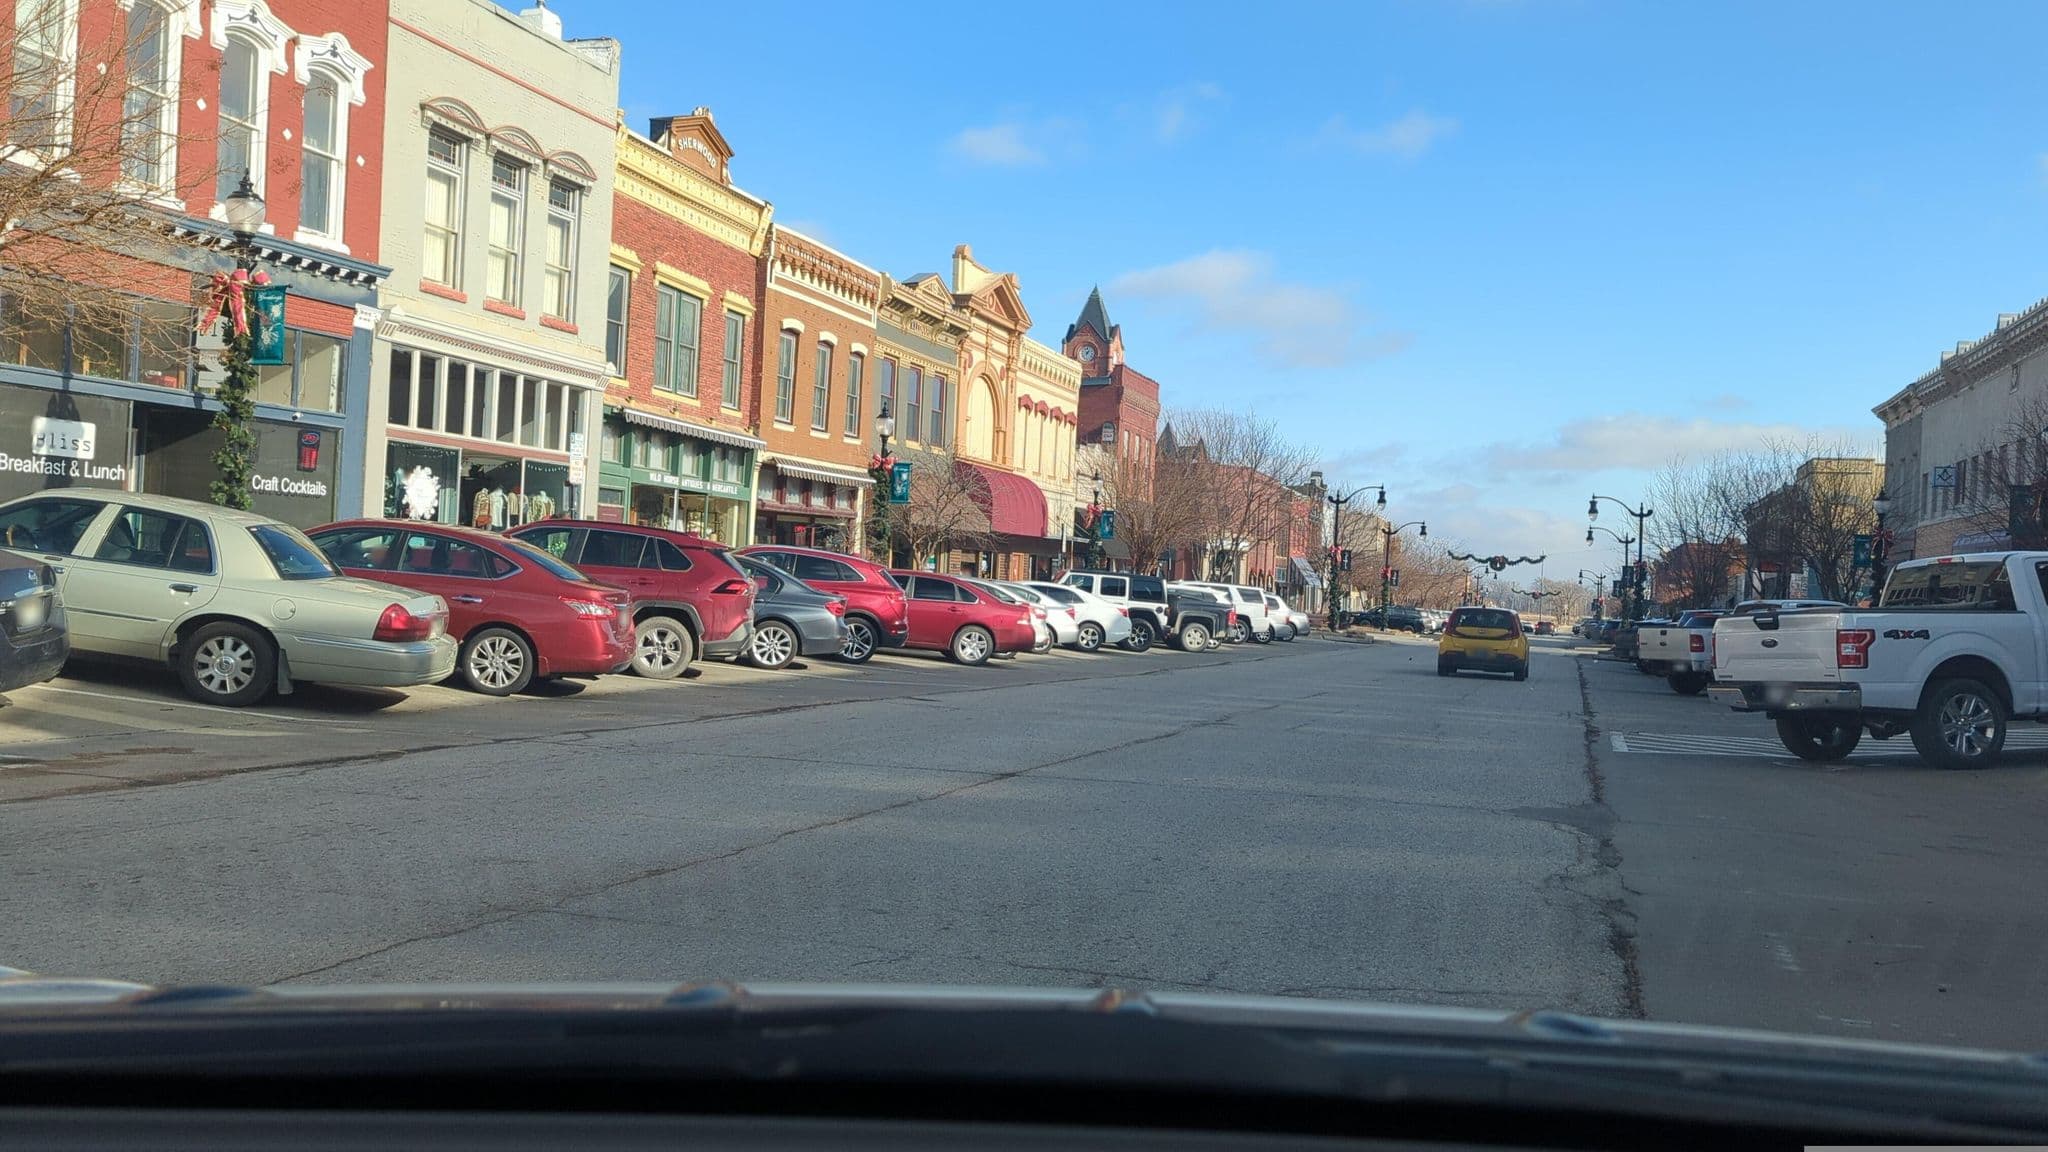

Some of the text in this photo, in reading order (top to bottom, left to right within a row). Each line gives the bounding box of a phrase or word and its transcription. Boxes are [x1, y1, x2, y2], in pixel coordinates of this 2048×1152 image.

[678, 136, 717, 168] SHERWOOD
[35, 433, 92, 452] Bliss
[0, 453, 126, 480] Breakfast & Lunch
[252, 475, 327, 496] Craft Cocktails
[681, 479, 703, 489] ANTIQUES
[712, 483, 738, 495] MERCANTILE
